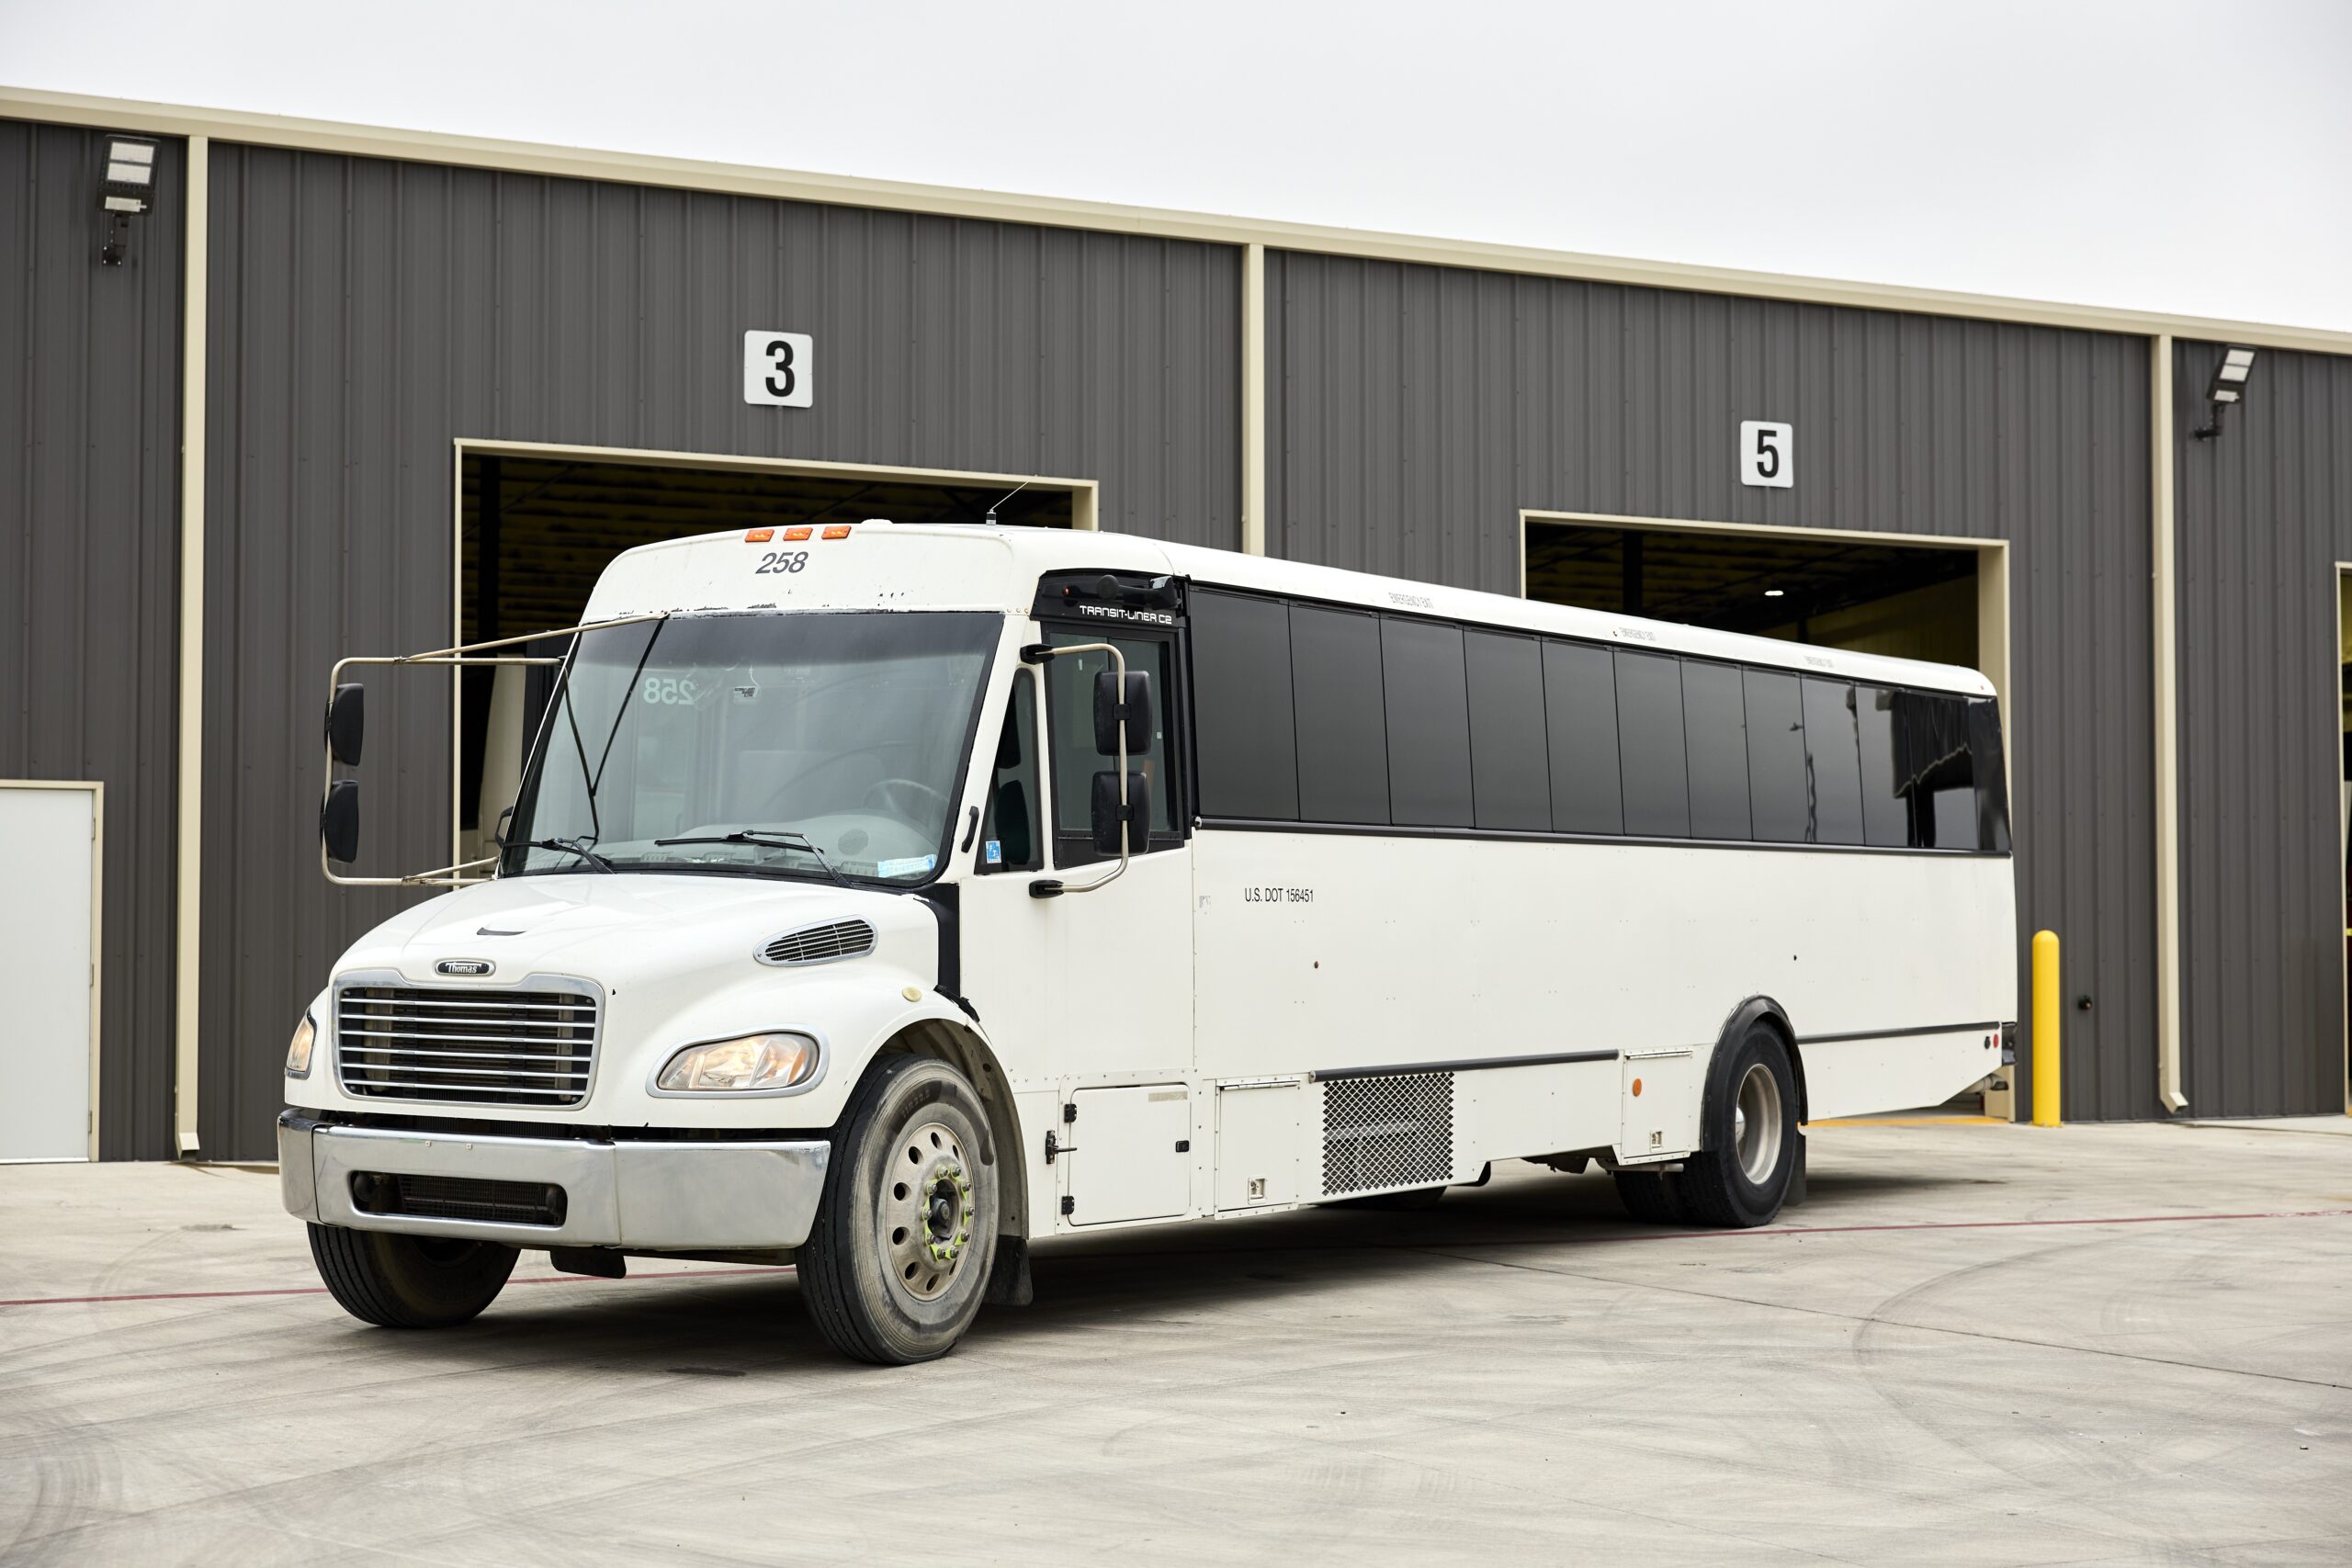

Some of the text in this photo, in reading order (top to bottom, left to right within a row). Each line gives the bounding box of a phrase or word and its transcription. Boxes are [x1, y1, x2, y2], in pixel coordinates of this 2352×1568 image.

[764, 340, 796, 398] 3
[1757, 429, 1780, 479] 5
[755, 551, 809, 574] 258
[1079, 605, 1172, 625] TRANSIT-LINER C2
[1244, 887, 1315, 902] U.S. DOT 156451
[445, 962, 482, 974] Thomas
